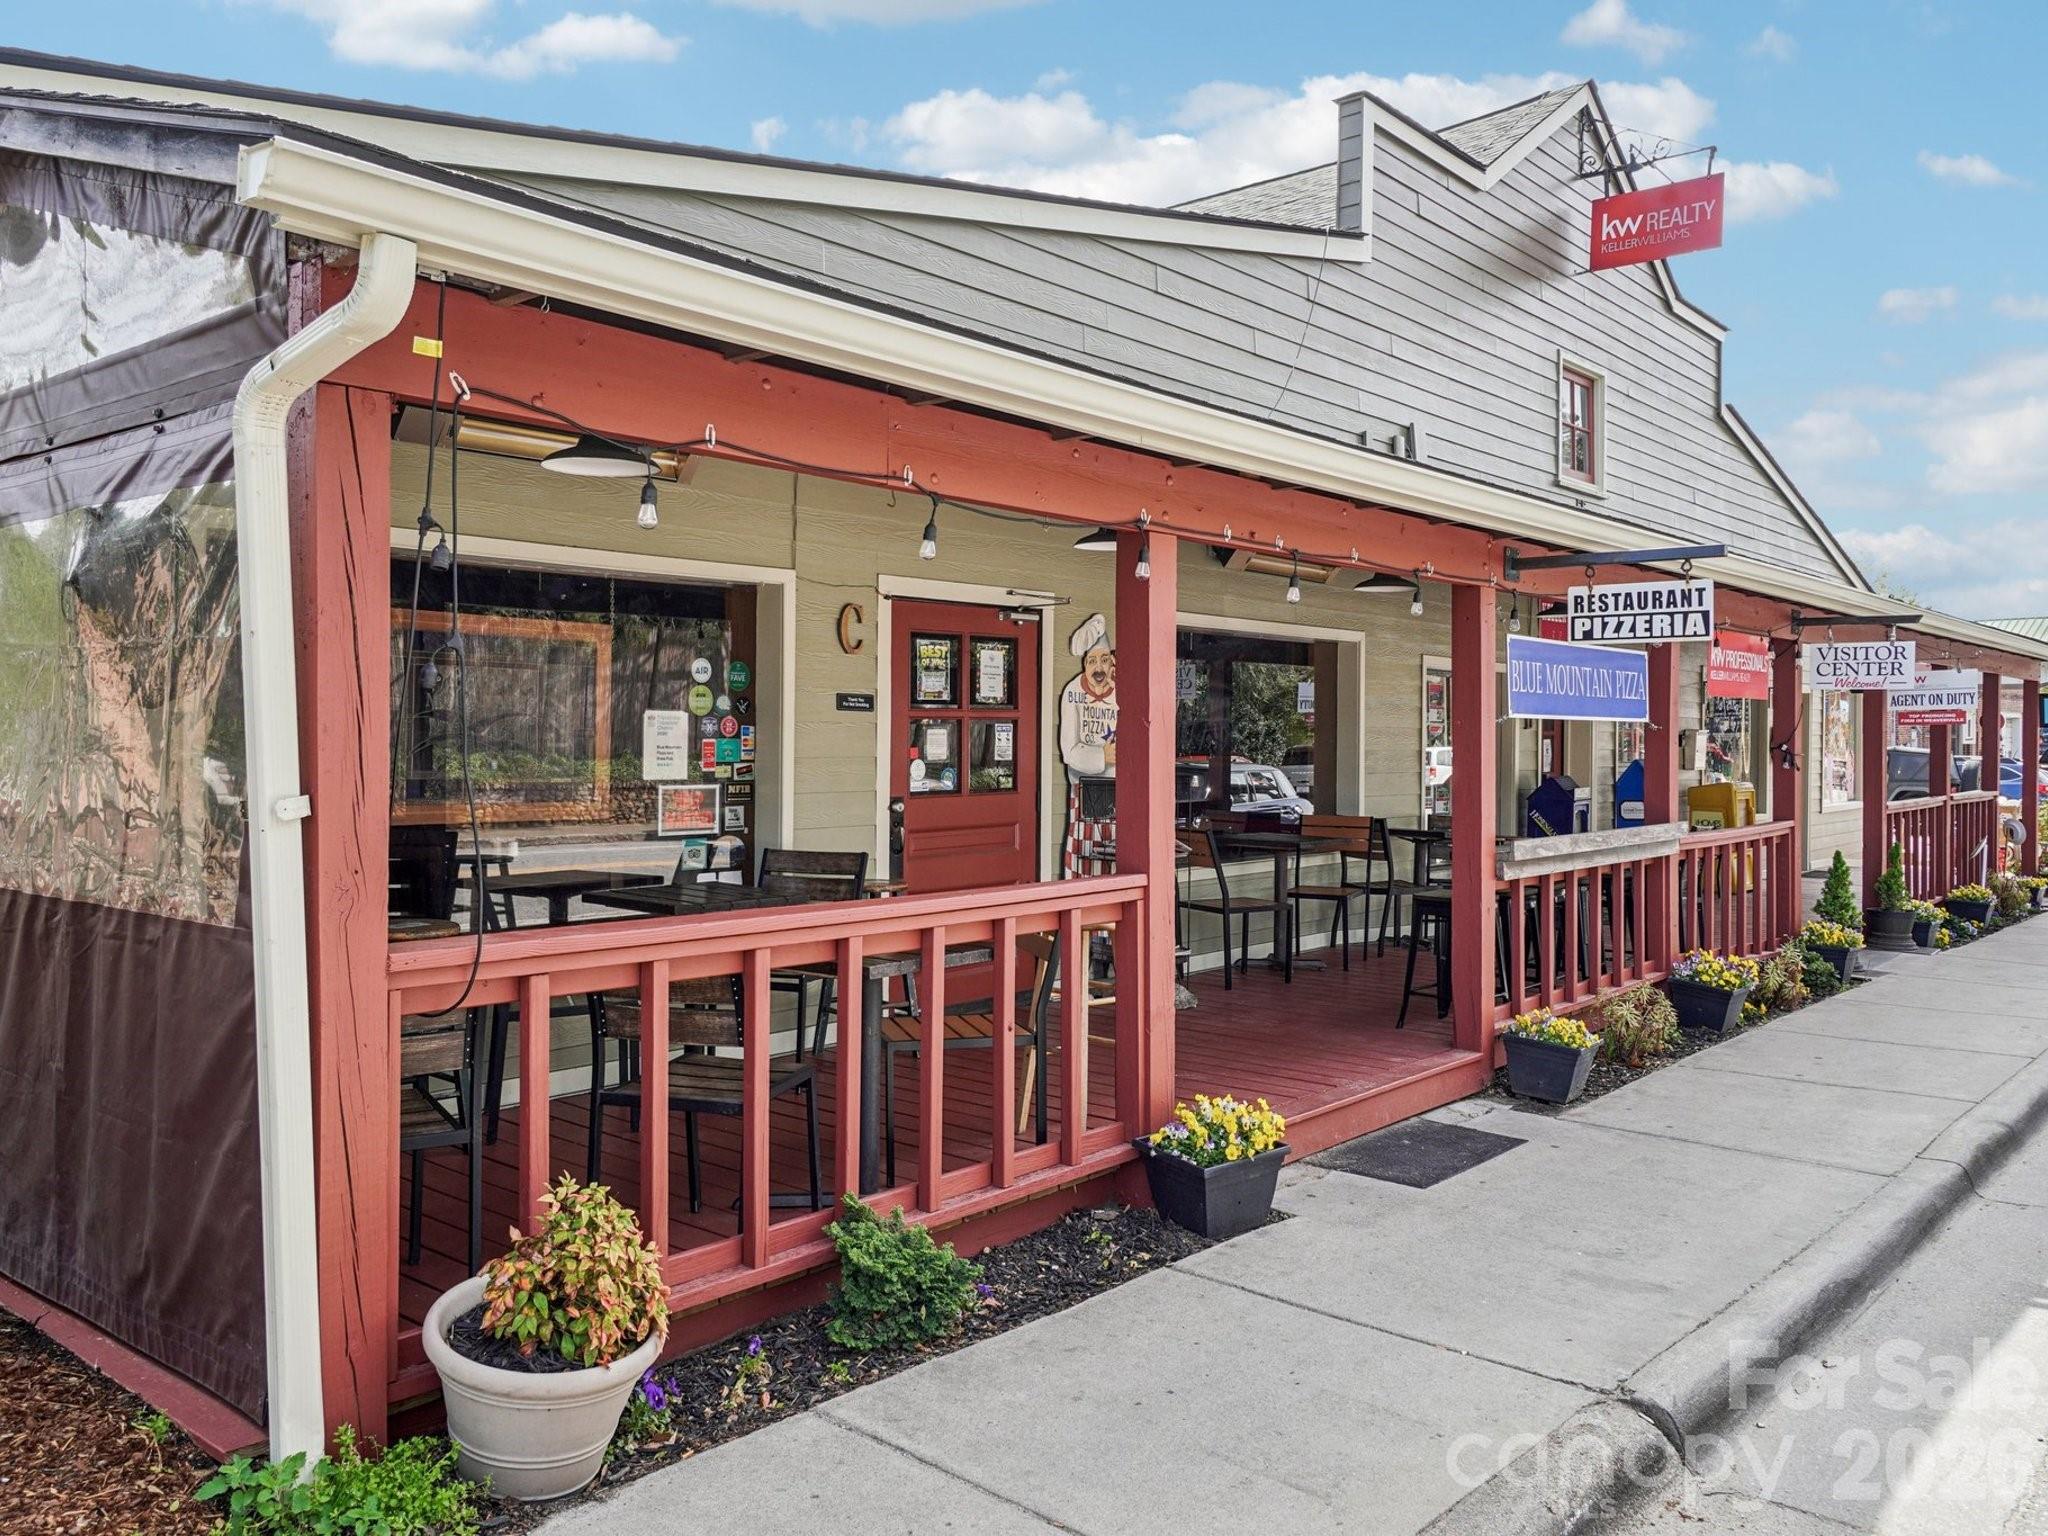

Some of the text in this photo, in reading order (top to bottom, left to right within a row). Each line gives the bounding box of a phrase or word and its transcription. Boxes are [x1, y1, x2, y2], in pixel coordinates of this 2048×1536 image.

[1645, 199, 1717, 232] REALTY
[1573, 586, 1707, 614] RESTAURANT
[1573, 612, 1707, 640] PIZZERIA
[920, 645, 948, 658] BEST
[1817, 645, 1908, 661] VISITOR
[1816, 661, 1905, 677] CENTER
[1511, 660, 1647, 702] BLUE MOUNTAIN PIZZA
[1834, 676, 1888, 688] Welcome!
[1068, 690, 1089, 704] BLUE
[1890, 691, 1977, 707] AGENT ON DUTY
[1082, 705, 1116, 720] MOUNTA
[1082, 720, 1105, 734] PIZZA
